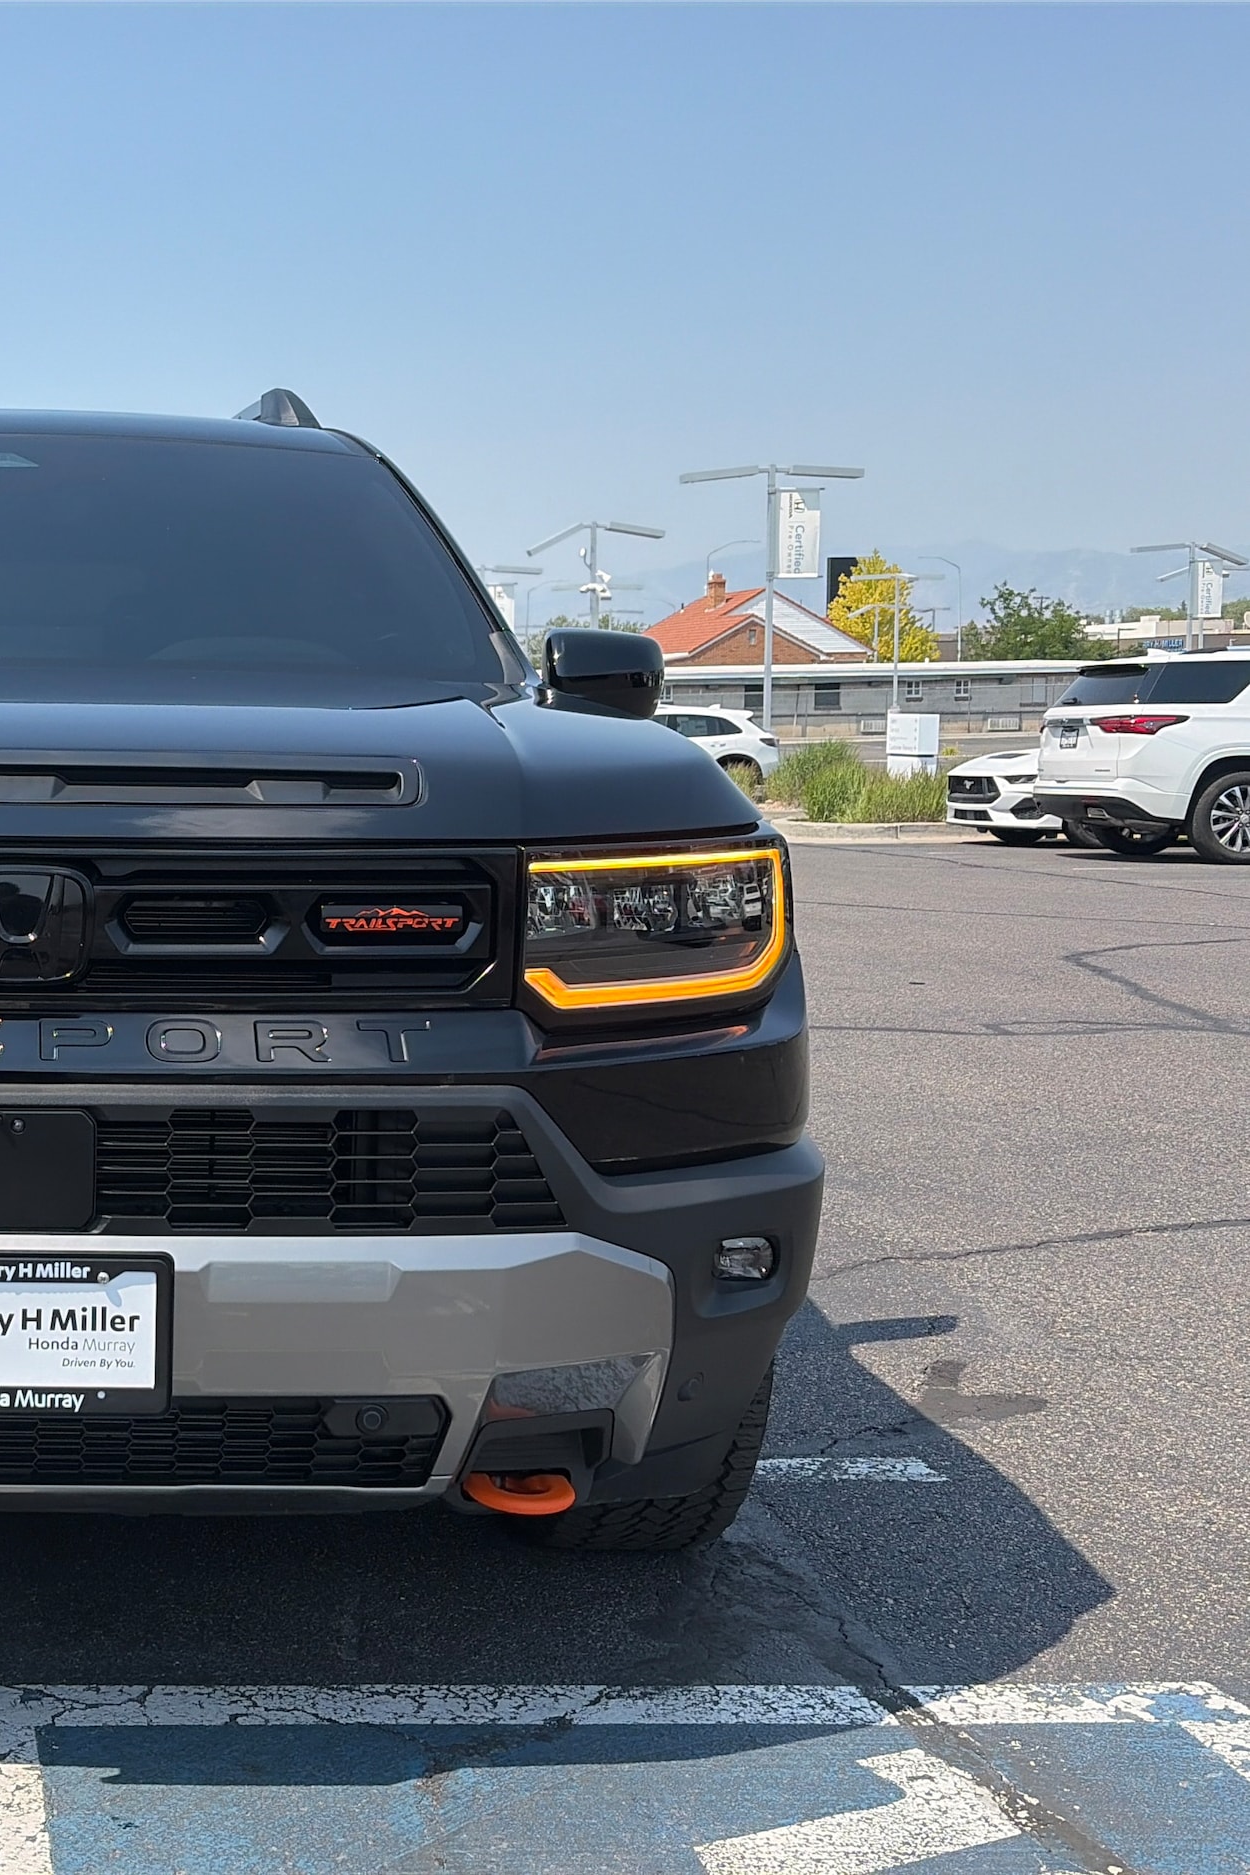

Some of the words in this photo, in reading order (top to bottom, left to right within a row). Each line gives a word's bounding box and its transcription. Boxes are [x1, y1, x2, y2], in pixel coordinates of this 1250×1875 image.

[325, 917, 459, 931] TRAILSPORT
[19, 1263, 35, 1278] H
[36, 1262, 91, 1279] Miller
[21, 1308, 42, 1330] H
[50, 1306, 140, 1332] Miller
[28, 1337, 78, 1351] Honda
[82, 1338, 136, 1354] Murray
[62, 1357, 97, 1368] Driven
[99, 1358, 112, 1370] By
[14, 1390, 85, 1412] Murray
